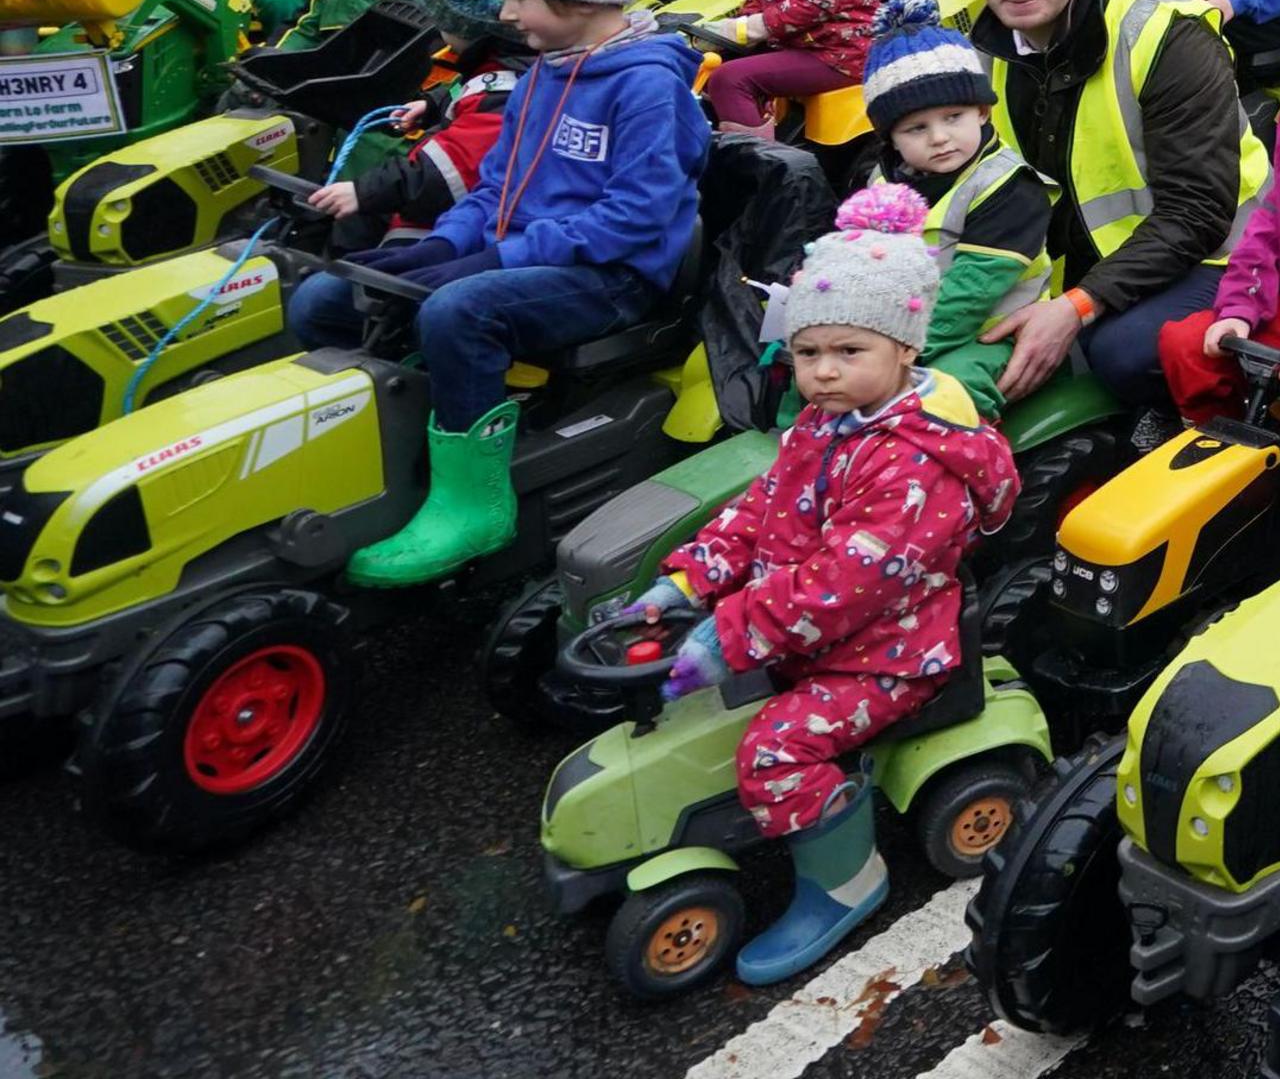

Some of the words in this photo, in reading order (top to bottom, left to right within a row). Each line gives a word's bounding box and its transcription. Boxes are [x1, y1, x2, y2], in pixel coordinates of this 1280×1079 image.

[73, 72, 88, 90] 4
[24, 105, 41, 117] to
[44, 103, 82, 115] farm
[256, 128, 287, 146] CLAAS
[558, 123, 601, 152] BBF
[314, 405, 357, 426] ARION
[137, 436, 203, 471] CLAAS
[1073, 565, 1094, 582] JCB
